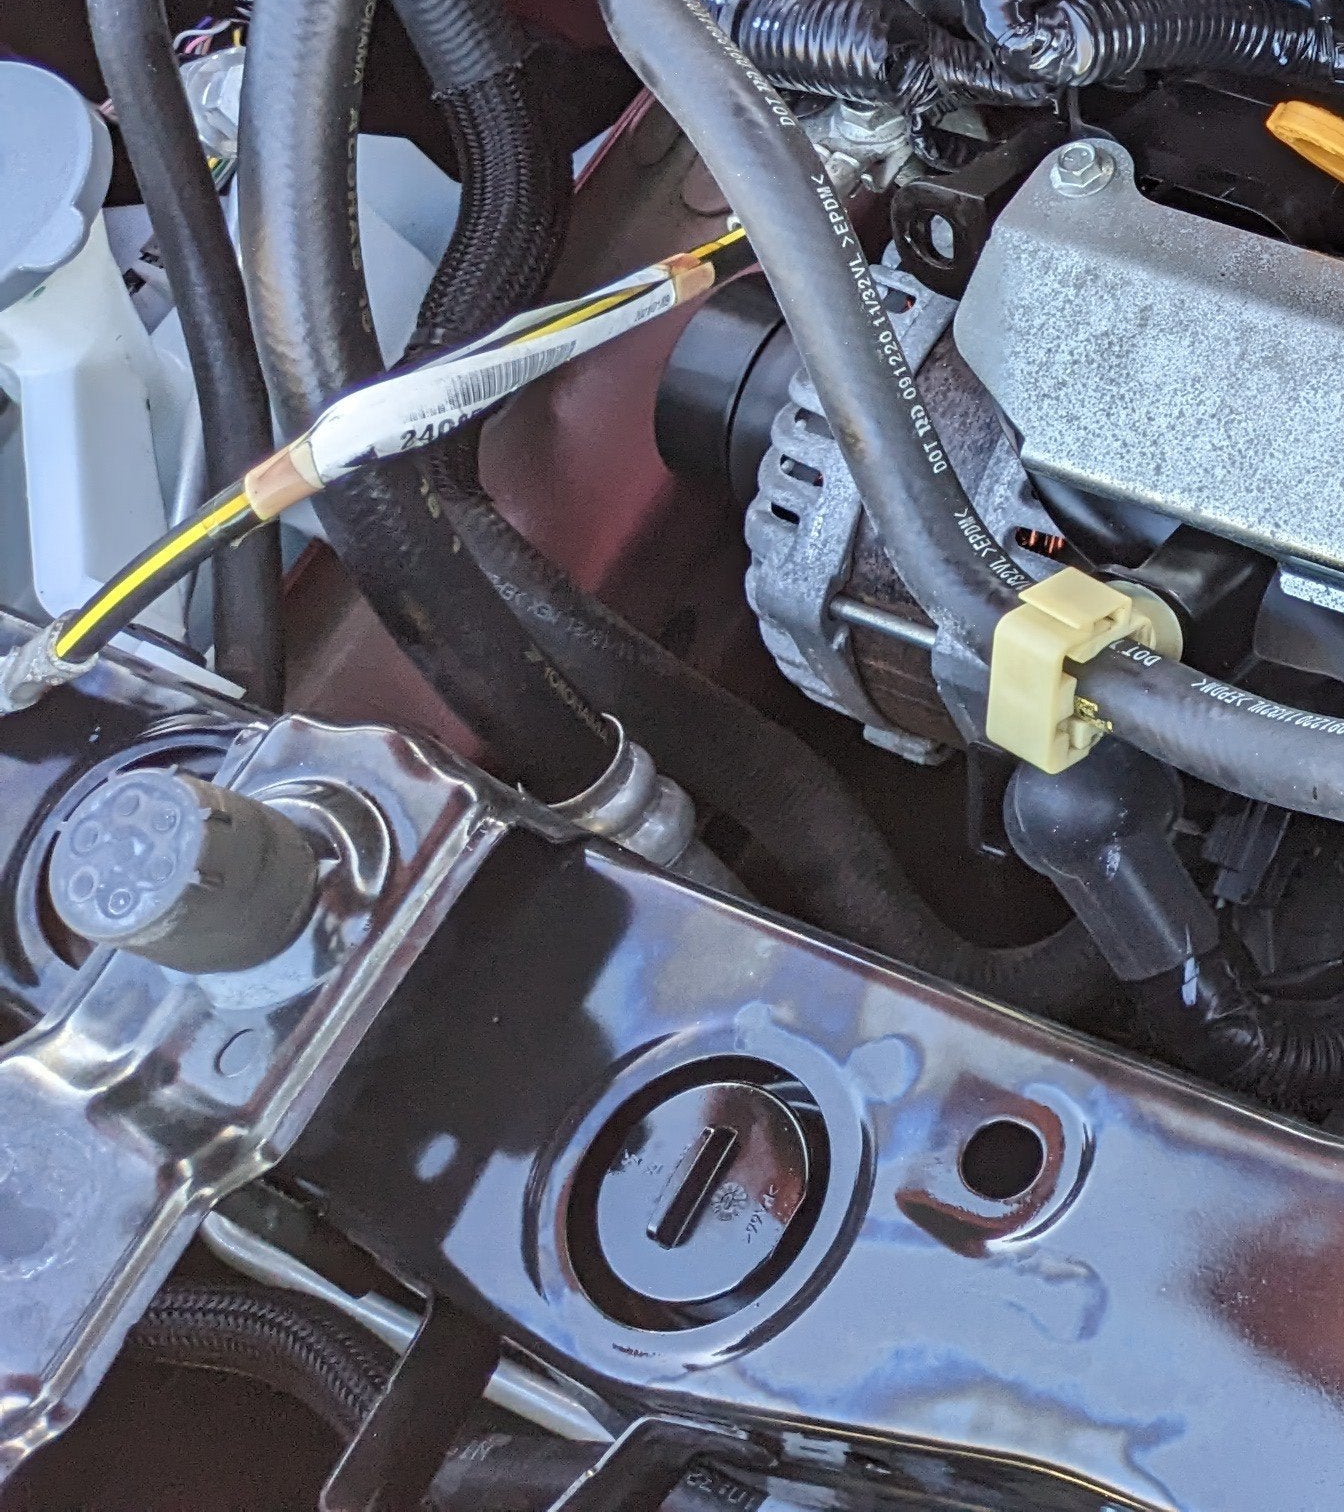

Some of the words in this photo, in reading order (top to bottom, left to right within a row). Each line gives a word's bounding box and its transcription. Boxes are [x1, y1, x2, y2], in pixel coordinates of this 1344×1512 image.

[879, 327, 916, 399] 091220
[924, 441, 947, 473] DOT
[1121, 647, 1161, 666] DOT
